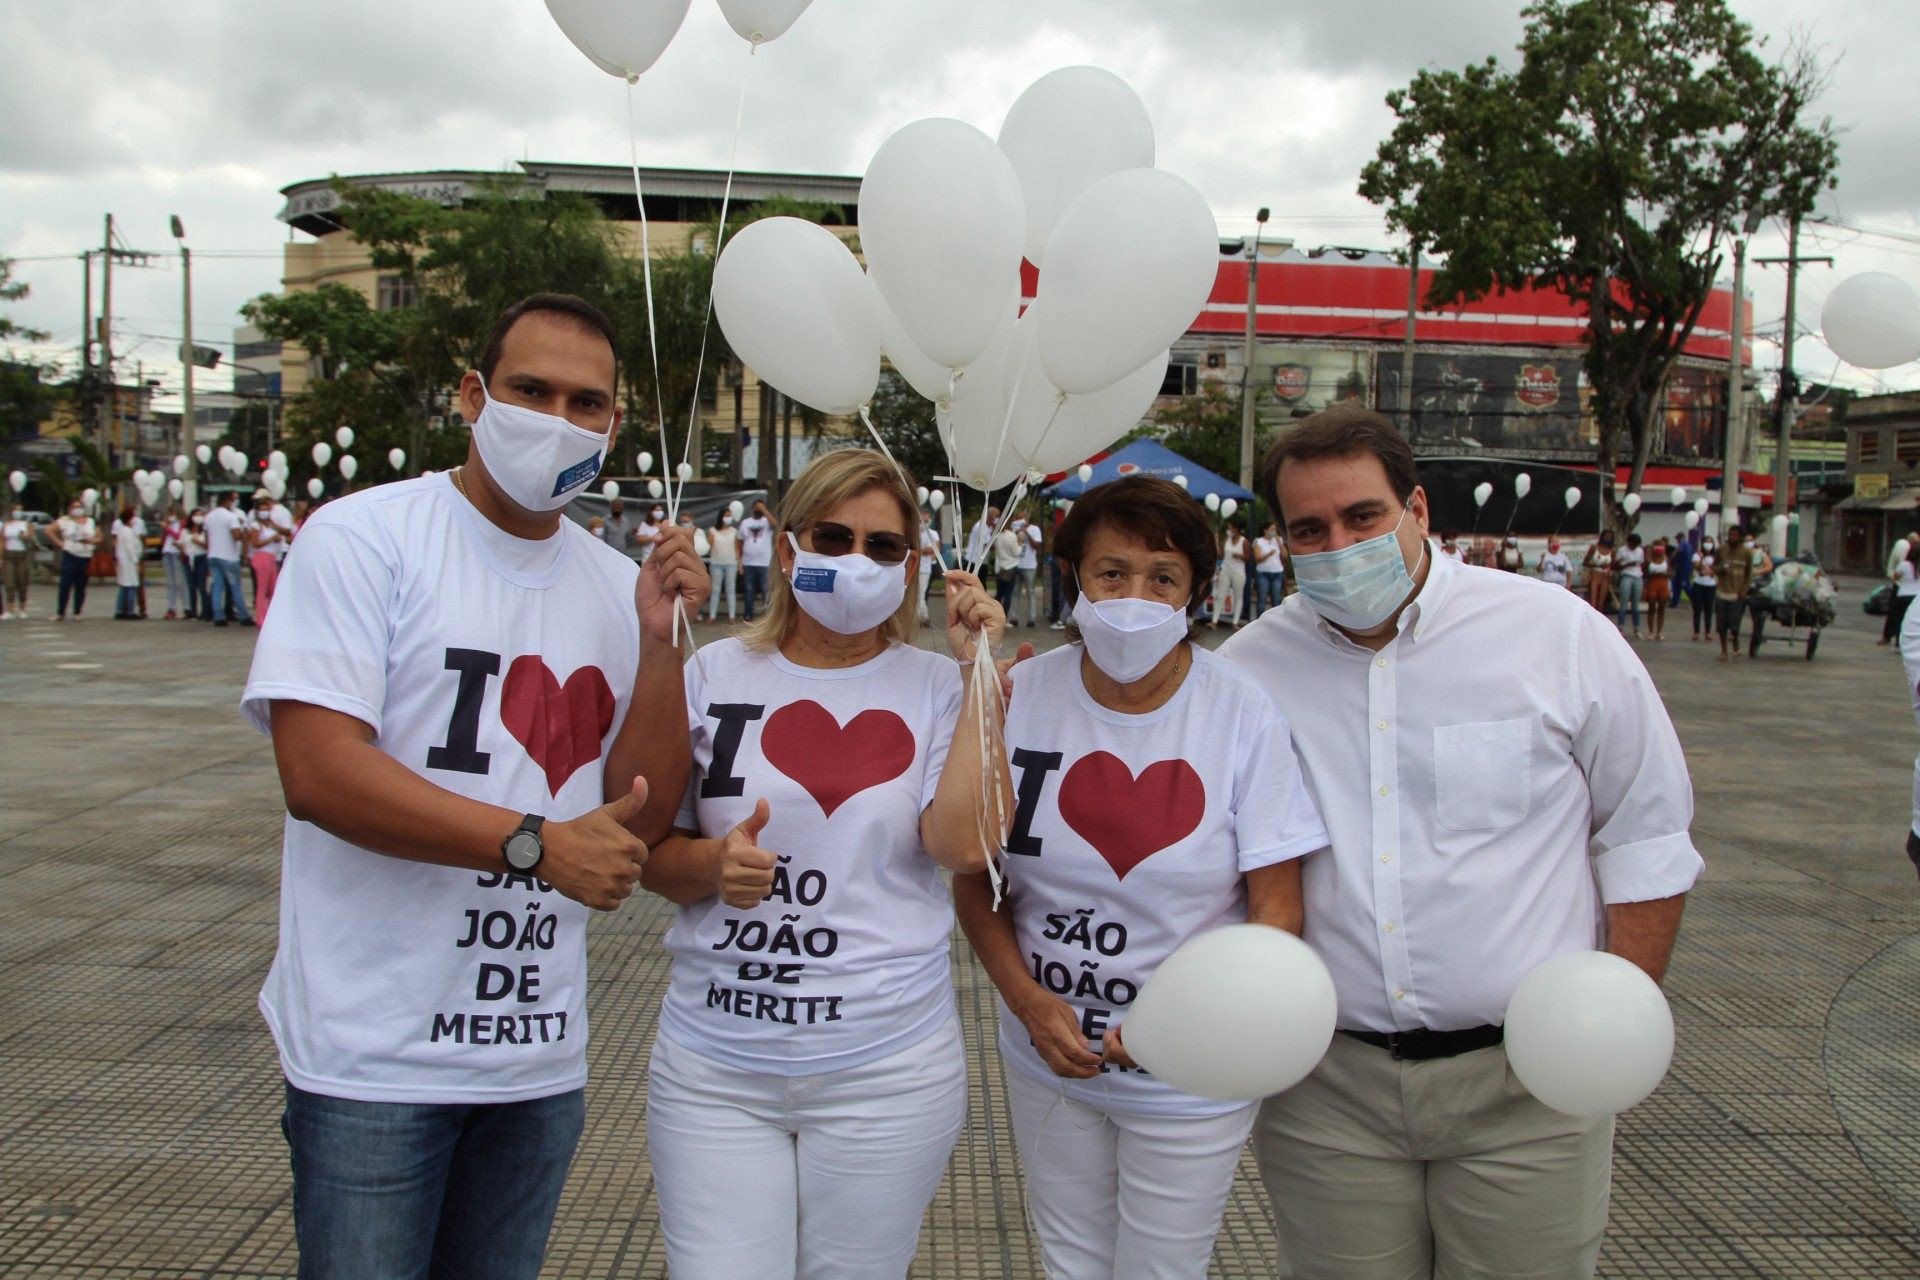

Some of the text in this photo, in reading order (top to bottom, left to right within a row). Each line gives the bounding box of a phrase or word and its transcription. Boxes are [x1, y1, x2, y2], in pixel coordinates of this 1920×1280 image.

[426, 647, 501, 775] I
[701, 703, 765, 798] I
[1002, 747, 1063, 857] I
[761, 855, 827, 906] ÃO
[456, 902, 558, 950] JOÃO
[712, 914, 838, 958] JOÃO
[1042, 909, 1127, 956] SÃO
[476, 962, 540, 1003] DE
[1031, 952, 1137, 1006] JOÃO
[707, 982, 843, 1025] MERITI
[1082, 1008, 1110, 1040] E
[430, 1011, 568, 1045] MERITI
